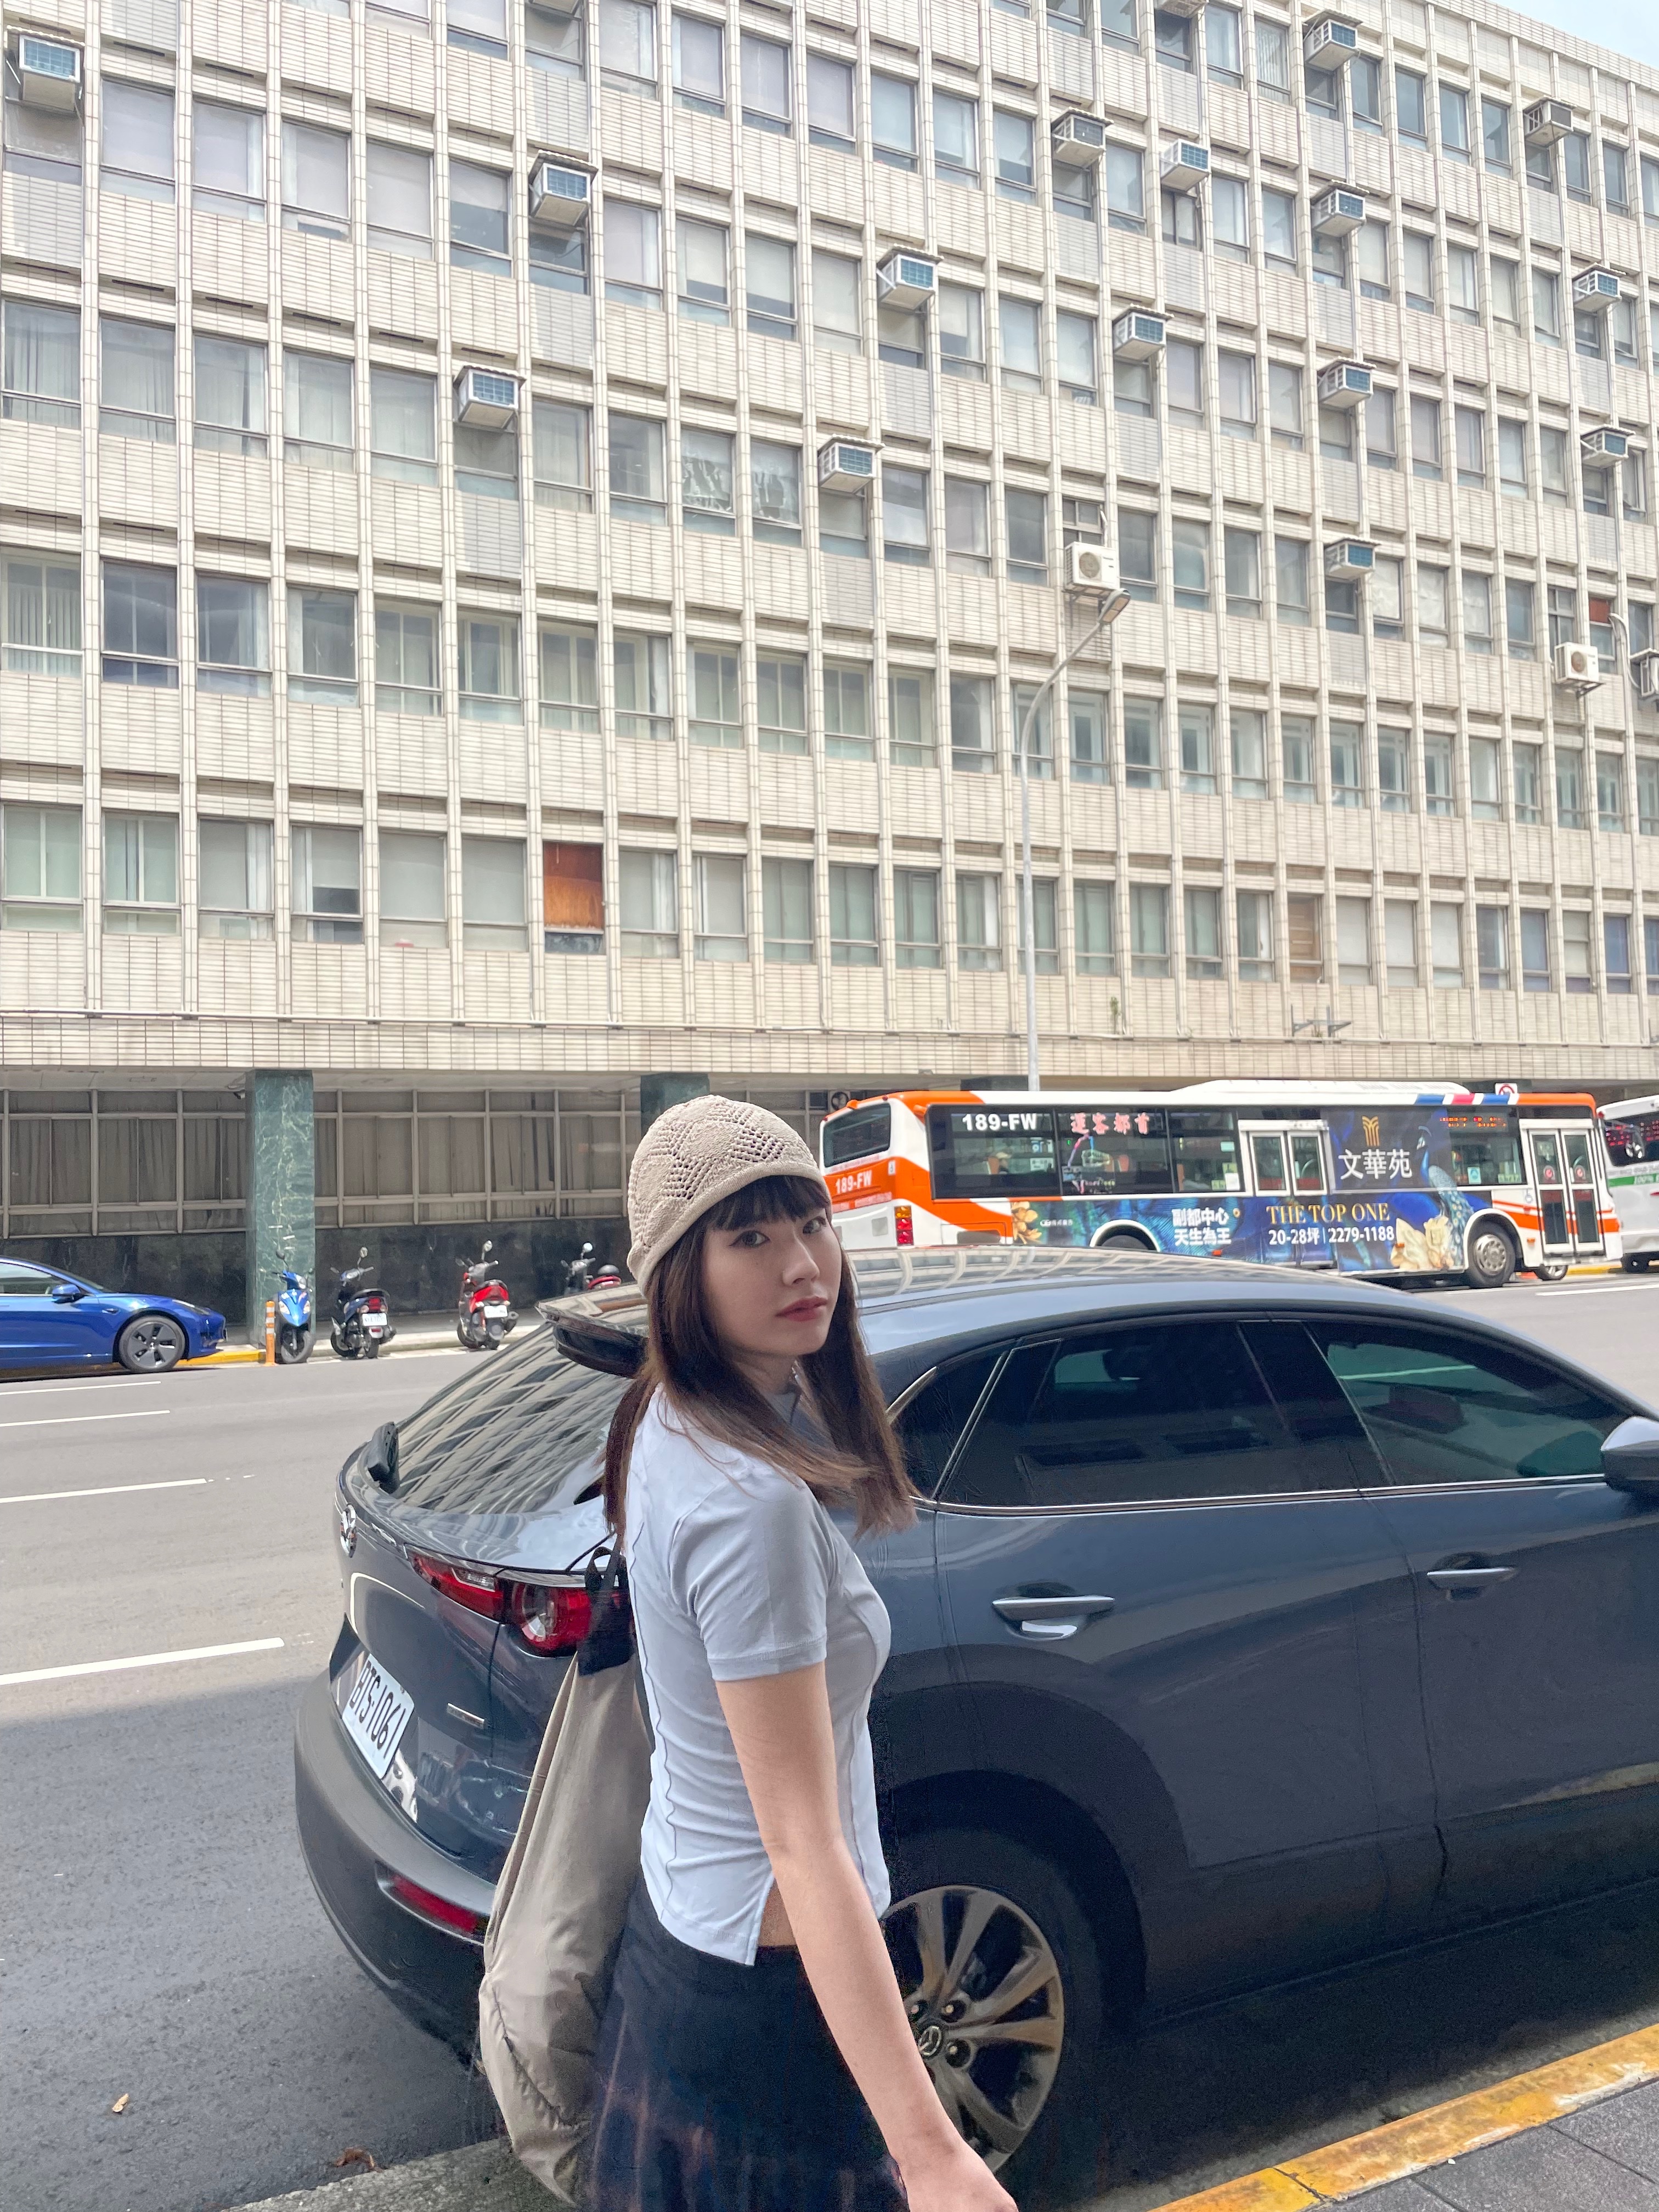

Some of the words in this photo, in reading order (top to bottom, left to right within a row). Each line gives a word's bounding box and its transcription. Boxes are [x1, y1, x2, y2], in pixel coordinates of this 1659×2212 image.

[962, 1113, 1036, 1131] 189-FW
[1338, 1149, 1412, 1180] 文華苑
[836, 1170, 872, 1194] 189-FW
[1172, 1207, 1229, 1227] 副都中心
[1266, 1205, 1306, 1224] THE
[1308, 1204, 1346, 1222] TOP
[1352, 1203, 1390, 1222] ONE
[1174, 1227, 1232, 1246] 天生為王
[1328, 1226, 1395, 1243] 2279-1188
[349, 1660, 406, 1759] BTS-1061
